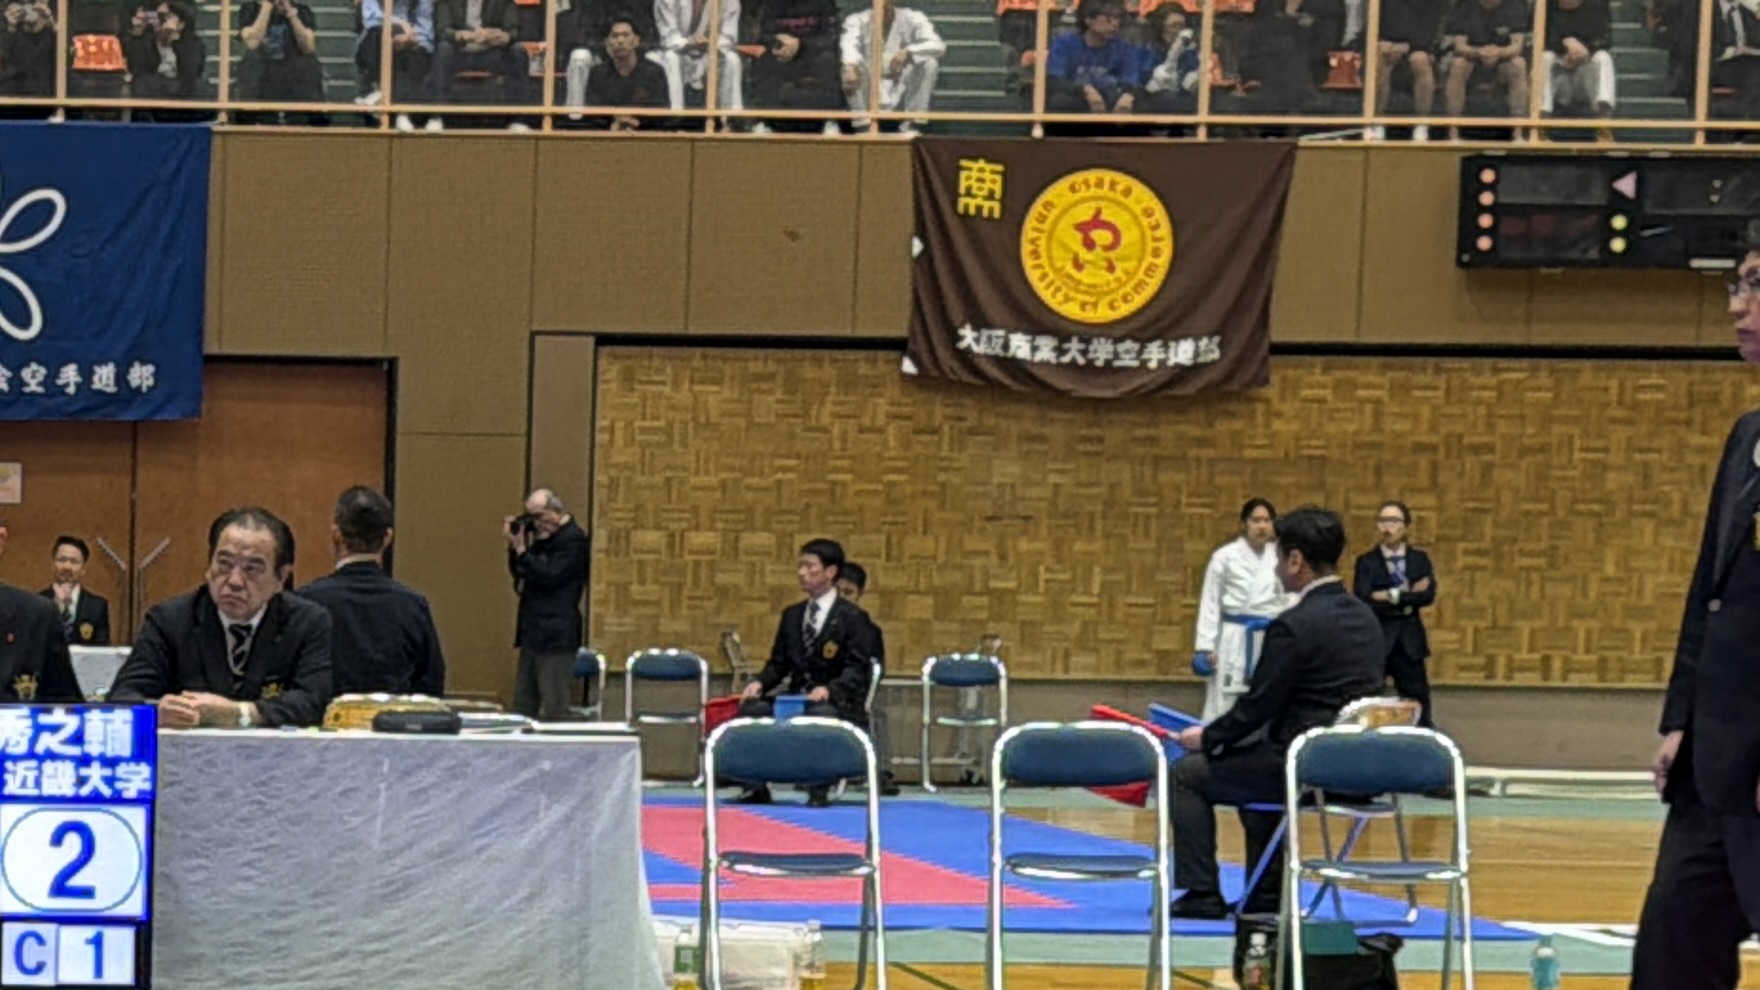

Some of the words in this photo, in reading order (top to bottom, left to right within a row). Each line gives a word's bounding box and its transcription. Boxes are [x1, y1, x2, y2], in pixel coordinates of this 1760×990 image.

[3, 760, 152, 799] 近畿大学
[47, 819, 97, 901] 2
[14, 930, 47, 976] C
[84, 930, 104, 979] 1
